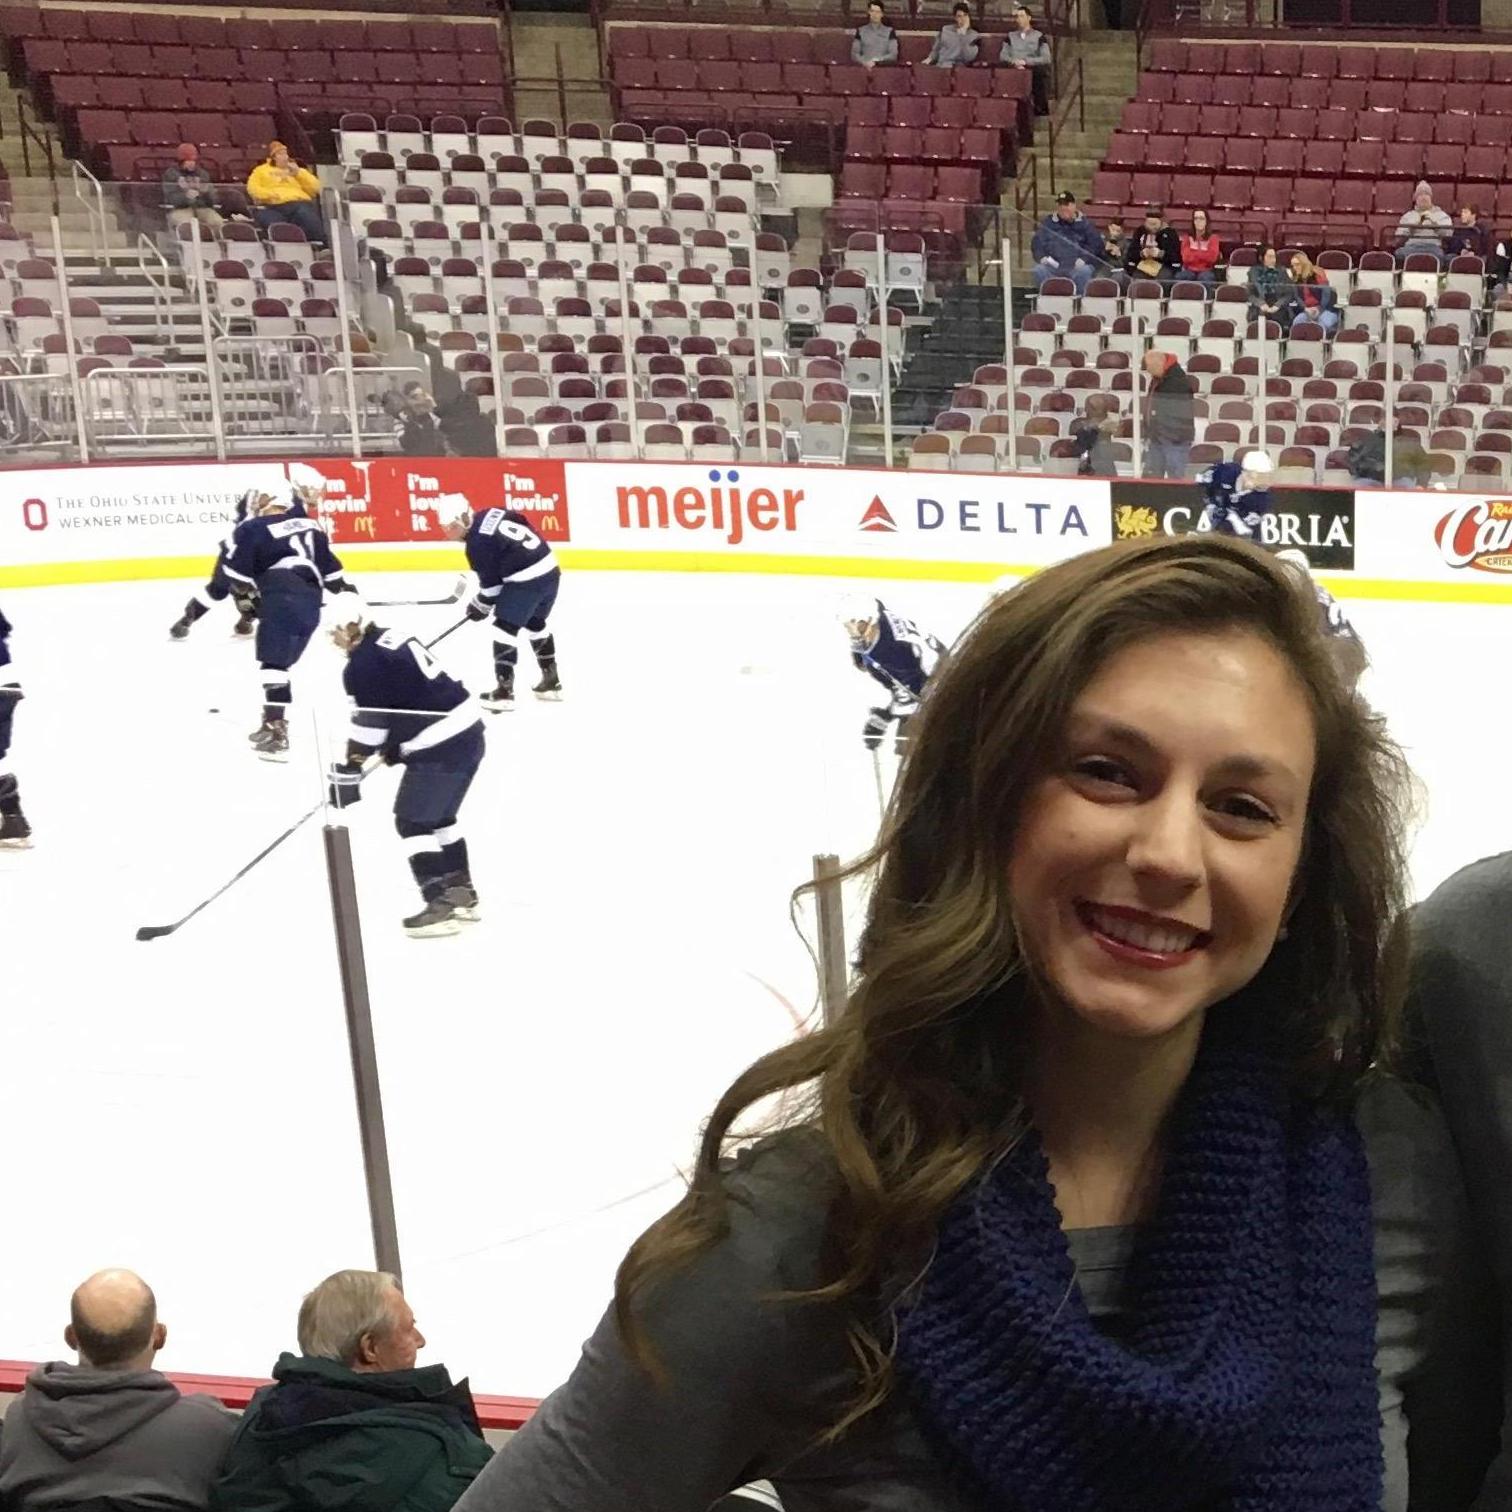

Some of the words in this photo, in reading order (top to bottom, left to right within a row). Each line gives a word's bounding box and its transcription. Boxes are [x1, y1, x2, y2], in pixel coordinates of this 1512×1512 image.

[407, 473, 439, 491] i'm
[503, 473, 535, 491] i'm
[56, 496, 84, 509] THE
[90, 495, 128, 508] OHIO
[133, 493, 176, 506] STATE
[183, 491, 243, 505] UNIVER
[505, 493, 559, 511] lovin'
[617, 470, 804, 544] meijer
[59, 515, 122, 529] WEXNER
[127, 513, 194, 526] MEDICAL
[199, 511, 231, 524] CEN
[917, 498, 1088, 537] DELTA
[1163, 506, 1352, 547] CABRIA
[499, 519, 541, 549] 9
